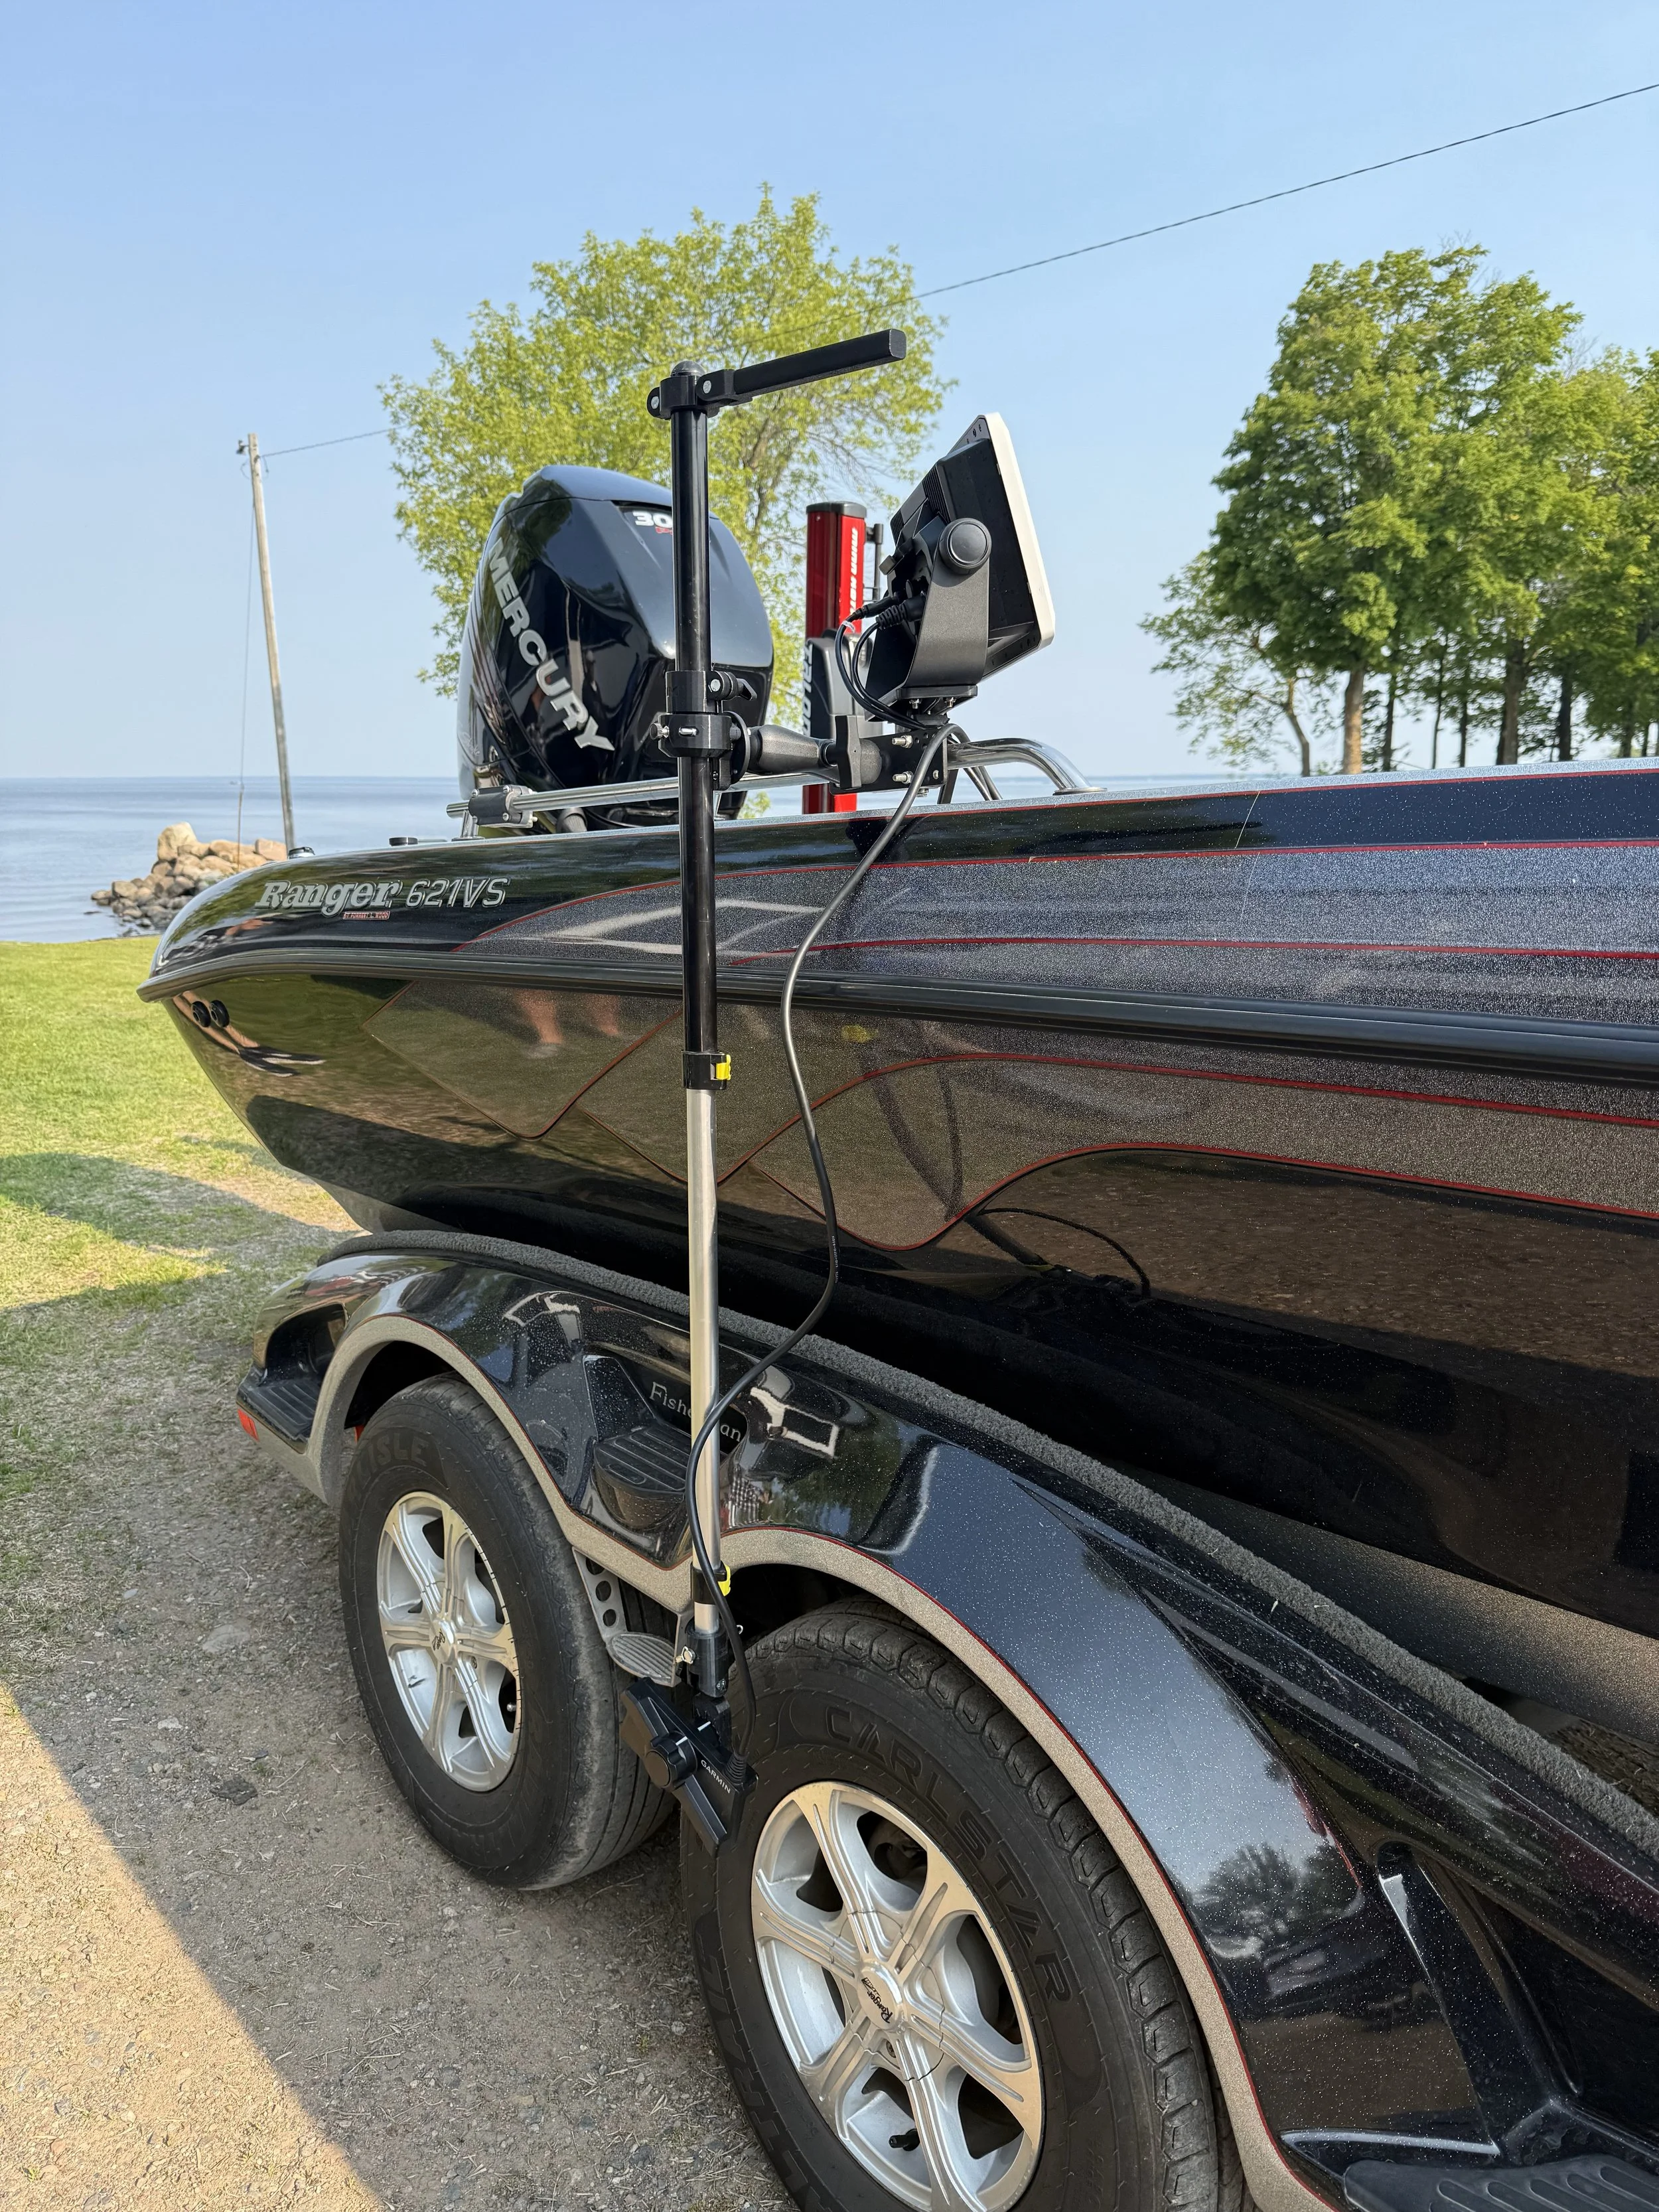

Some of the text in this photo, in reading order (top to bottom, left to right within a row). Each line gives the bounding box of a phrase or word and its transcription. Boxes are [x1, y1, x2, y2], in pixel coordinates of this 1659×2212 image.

[632, 510, 673, 529] 30
[488, 537, 614, 751] MERCURY
[255, 877, 511, 918] Ranger 621VS
[650, 1381, 742, 1443] Fishan
[700, 1759, 731, 1795] GARMIN
[867, 1990, 893, 2024] Ranger
